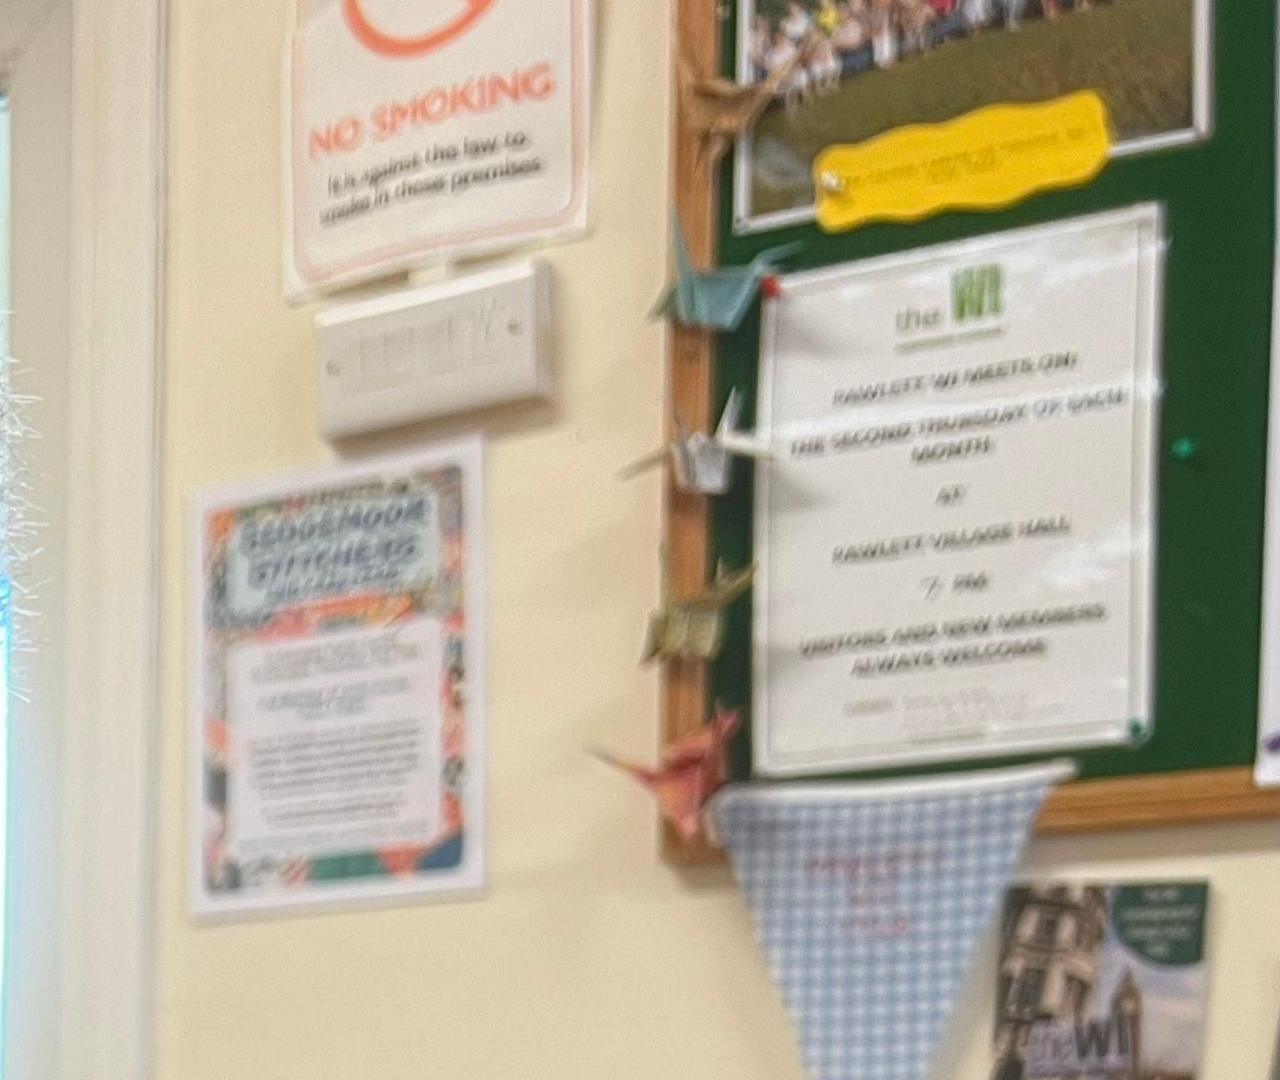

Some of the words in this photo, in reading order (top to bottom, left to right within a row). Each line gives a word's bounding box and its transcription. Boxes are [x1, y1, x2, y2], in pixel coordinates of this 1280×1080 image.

[308, 116, 363, 160] NO
[370, 62, 557, 141] SMOKING
[424, 144, 459, 163] the
[463, 135, 498, 156] law
[505, 130, 529, 148] to
[374, 187, 390, 208] in
[896, 305, 941, 331] the
[950, 263, 1004, 323] WI
[964, 357, 1033, 384] MEETS
[790, 438, 826, 457] THE
[830, 422, 912, 450] SECOND
[917, 403, 1029, 435] THURSDAY
[1067, 387, 1127, 411] EACH
[911, 434, 993, 465] MONTH
[929, 521, 1014, 548] VILLAGE
[1018, 513, 1071, 539] HALL
[800, 629, 887, 656] VISITORS
[891, 621, 938, 645] AND
[942, 614, 990, 638] NEW
[995, 602, 1107, 630] MEMBERS
[850, 650, 935, 677] ALWAYS
[942, 637, 1046, 664] WELCOME
